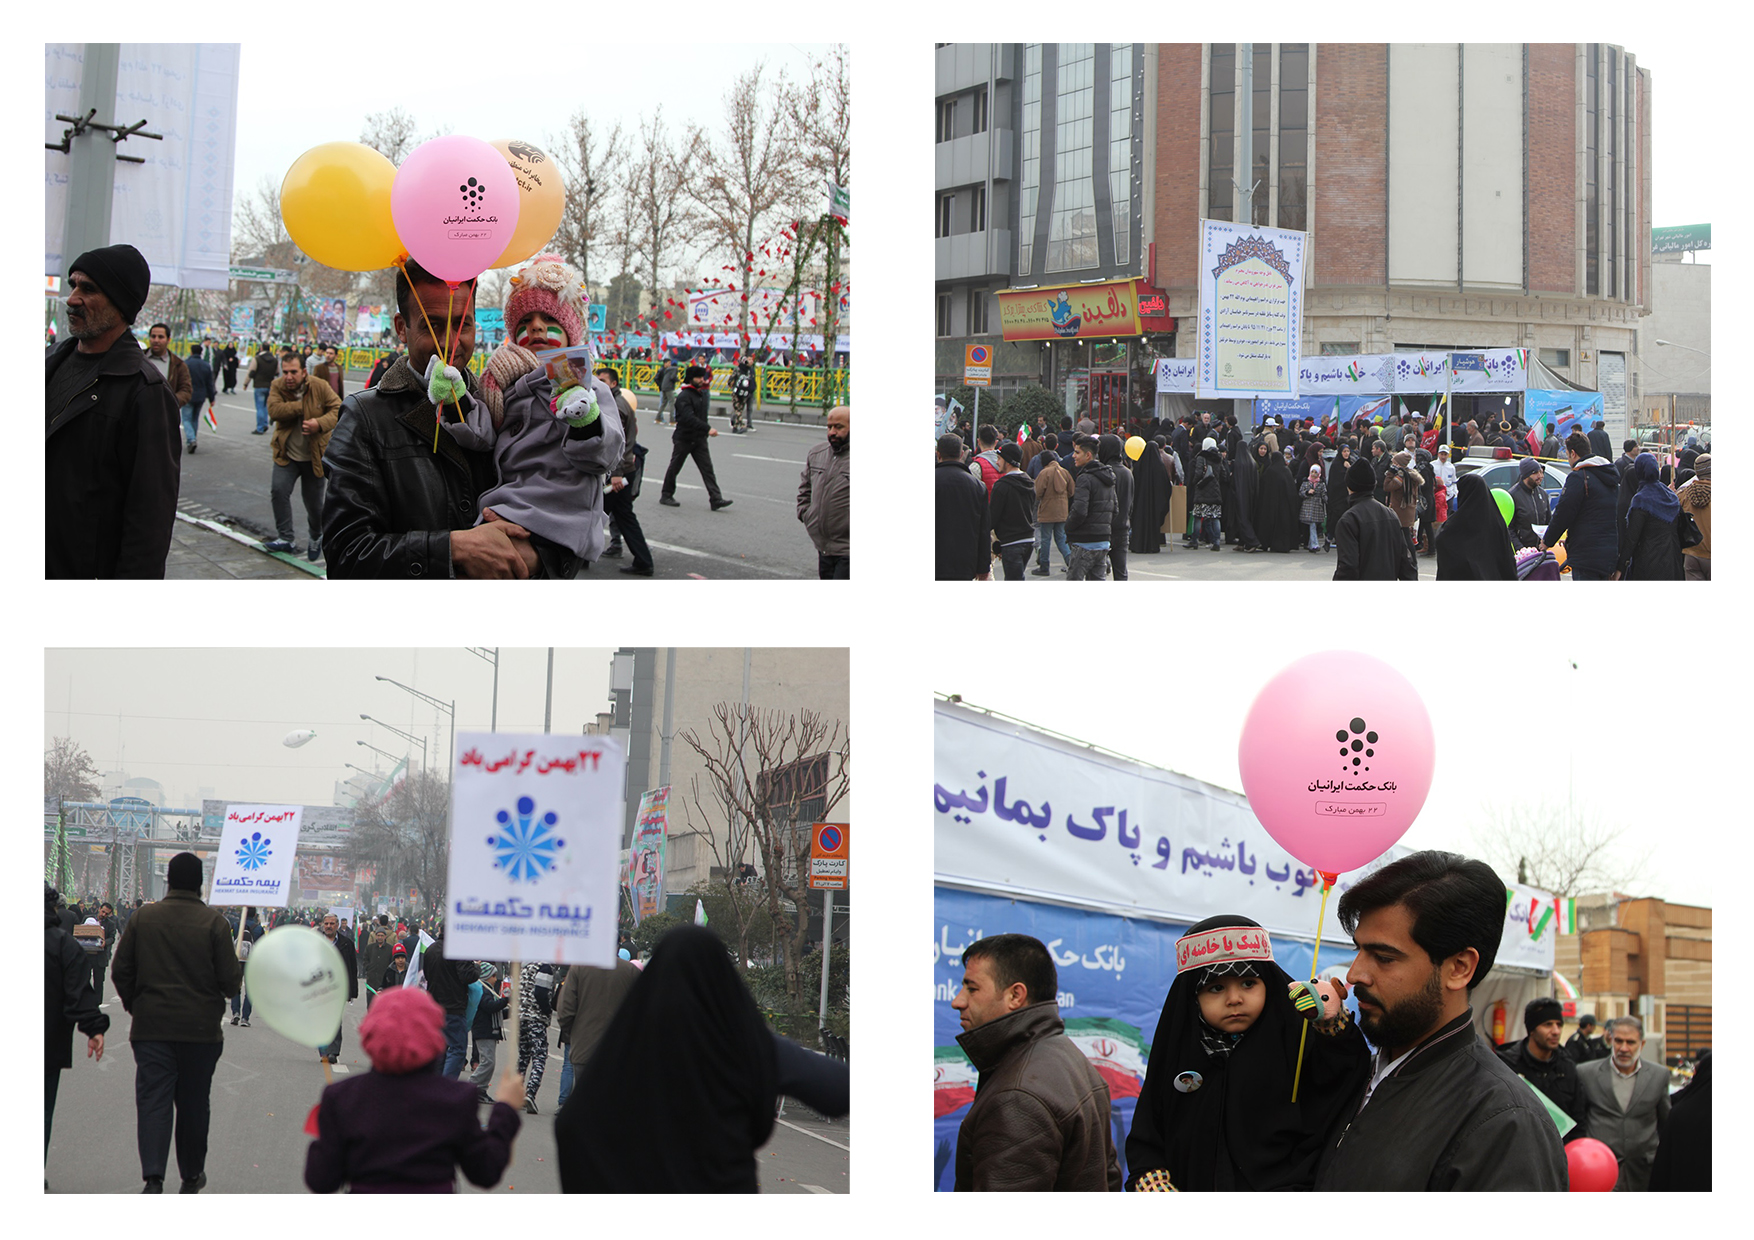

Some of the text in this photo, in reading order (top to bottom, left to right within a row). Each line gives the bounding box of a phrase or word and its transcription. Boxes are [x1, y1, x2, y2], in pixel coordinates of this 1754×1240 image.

[516, 177, 532, 192] ct.ir
[442, 216, 466, 224] ایرانیان
[486, 216, 498, 224] بانک
[1082, 286, 1127, 324] دلفین
[1138, 296, 1164, 314] دلفین
[1313, 373, 1319, 382] و
[1321, 368, 1342, 382] باشیم
[1308, 779, 1397, 793] بانک حکمت ایرانیان
[1325, 805, 1347, 814] مبارک
[1066, 806, 1141, 866] پاک
[1151, 836, 1171, 870] و
[1182, 837, 1257, 886] باشیم
[216, 877, 281, 890] بیمه حکمت
[456, 896, 592, 928] بیمه حکمت
[1047, 938, 1080, 967] حک
[1180, 934, 1260, 966] لبیک یا خامنه ای
[1082, 944, 1126, 981] بانک
